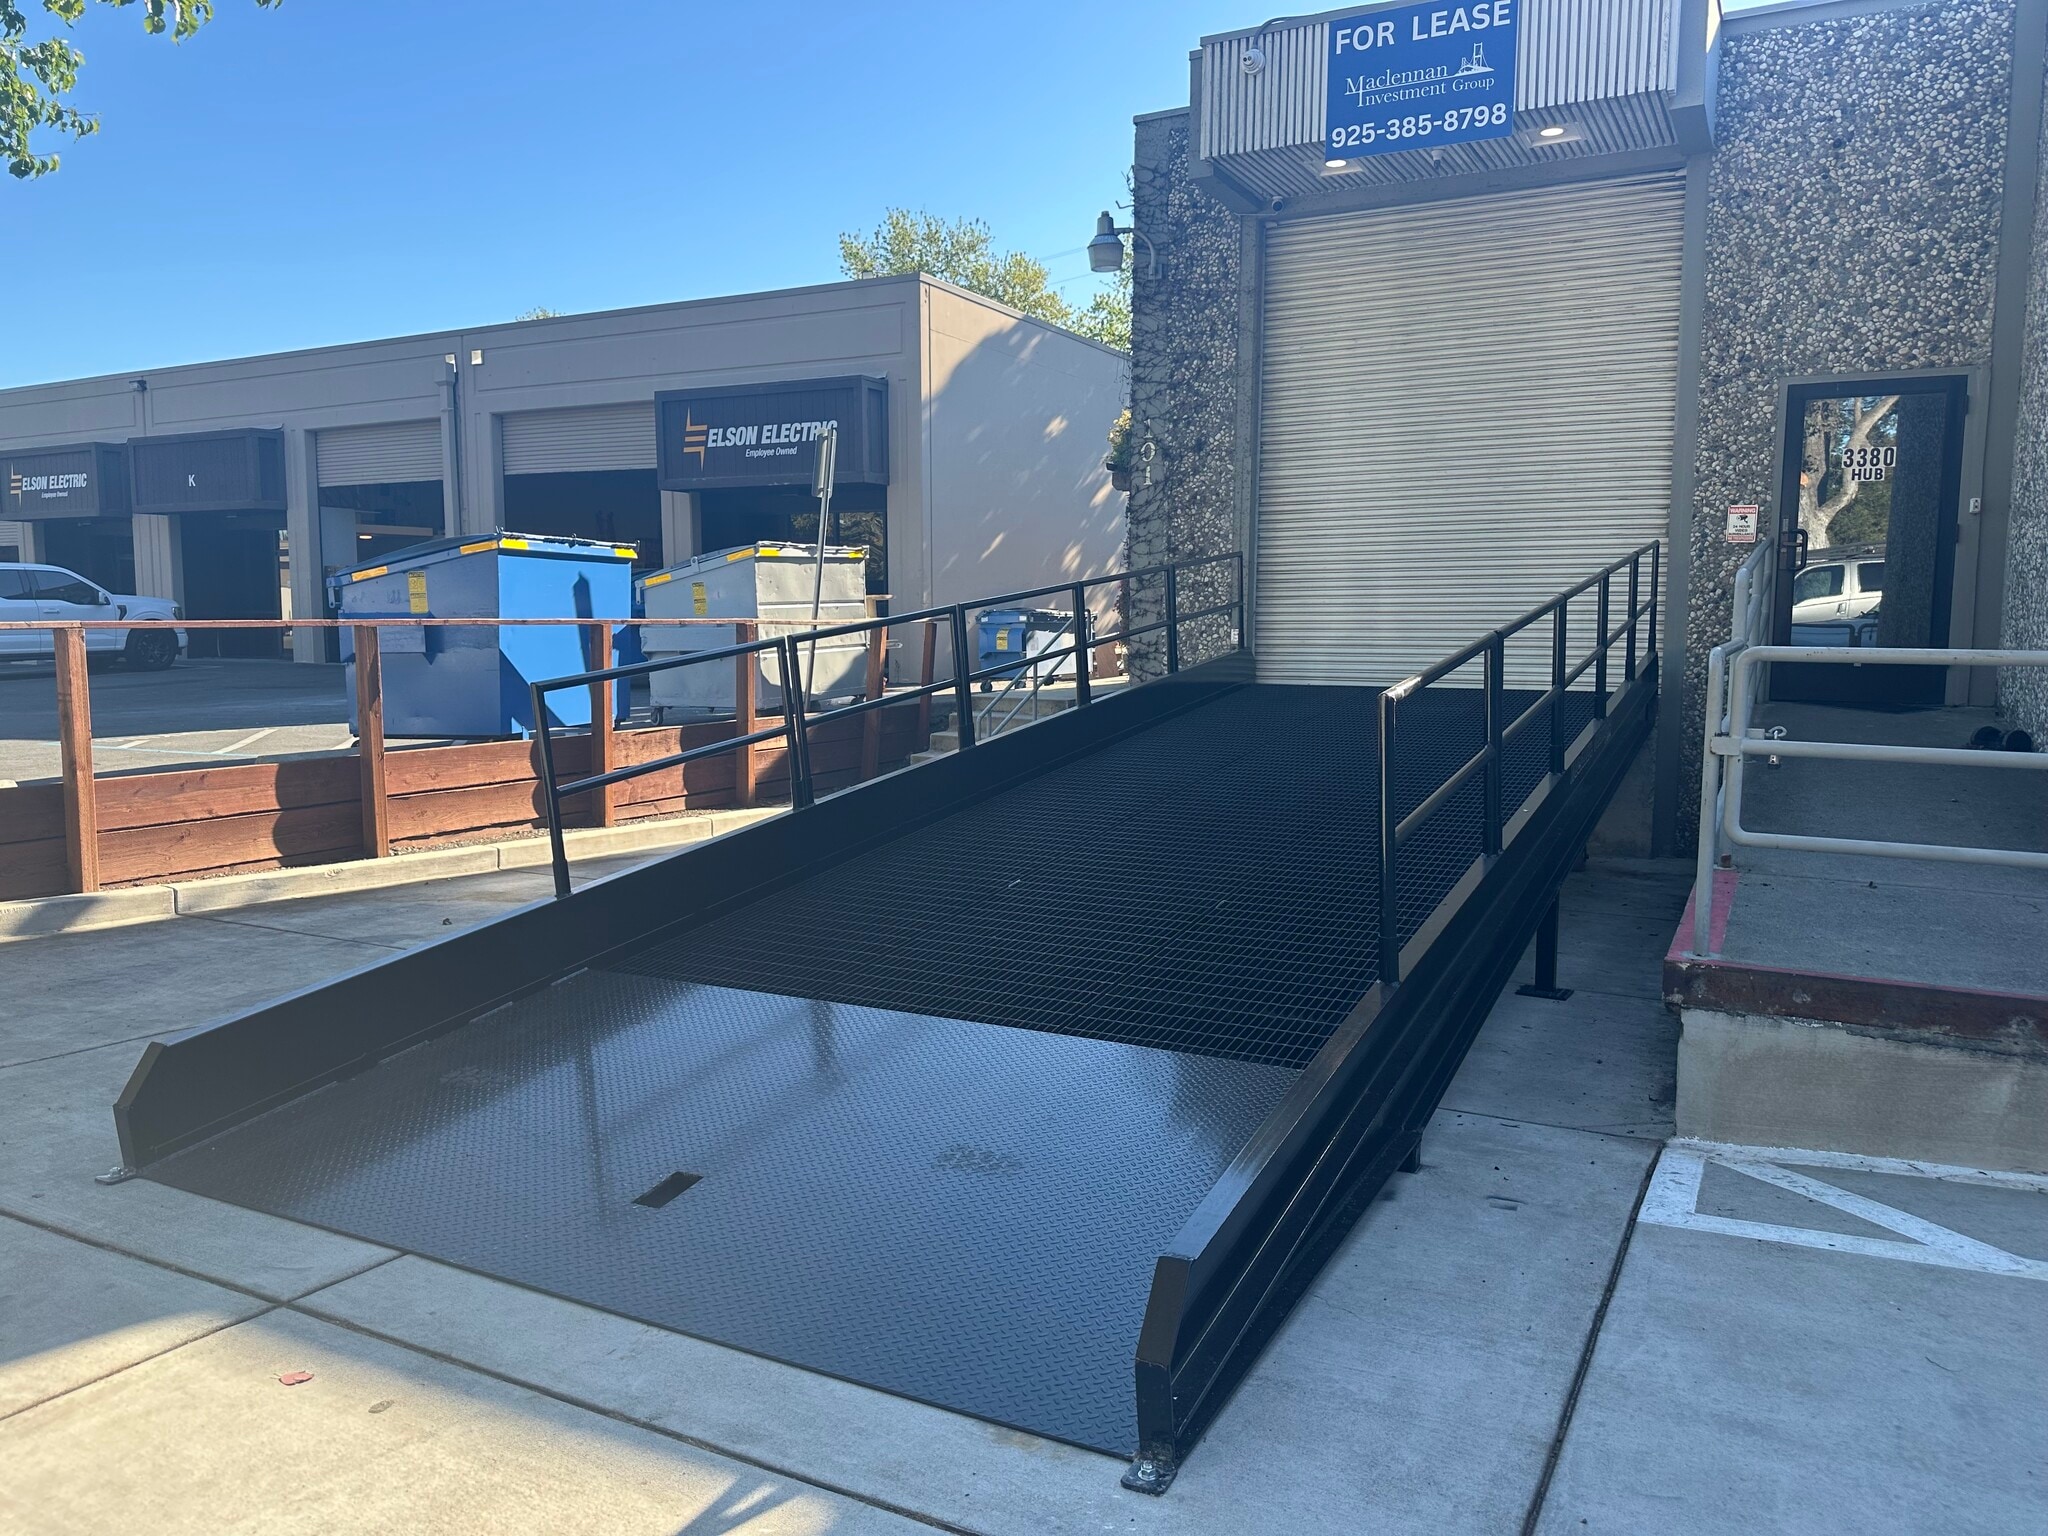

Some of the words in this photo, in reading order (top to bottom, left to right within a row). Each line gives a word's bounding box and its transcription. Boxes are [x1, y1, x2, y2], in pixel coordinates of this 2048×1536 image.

[1336, 21, 1395, 55] FOR
[1412, 0, 1511, 41] LEASE
[1345, 65, 1448, 95] Maclennan
[1357, 82, 1447, 107] Investment
[1452, 77, 1495, 92] Group
[1331, 103, 1507, 148] 925-385-8798
[707, 425, 759, 448] ELSON
[745, 448, 775, 459] Employee
[775, 446, 798, 456] Owned
[1843, 447, 1895, 468] 3380
[22, 476, 48, 491] ELSON
[49, 473, 87, 490] ELECTRIC
[188, 474, 196, 487] K
[1851, 468, 1884, 481] HUB
